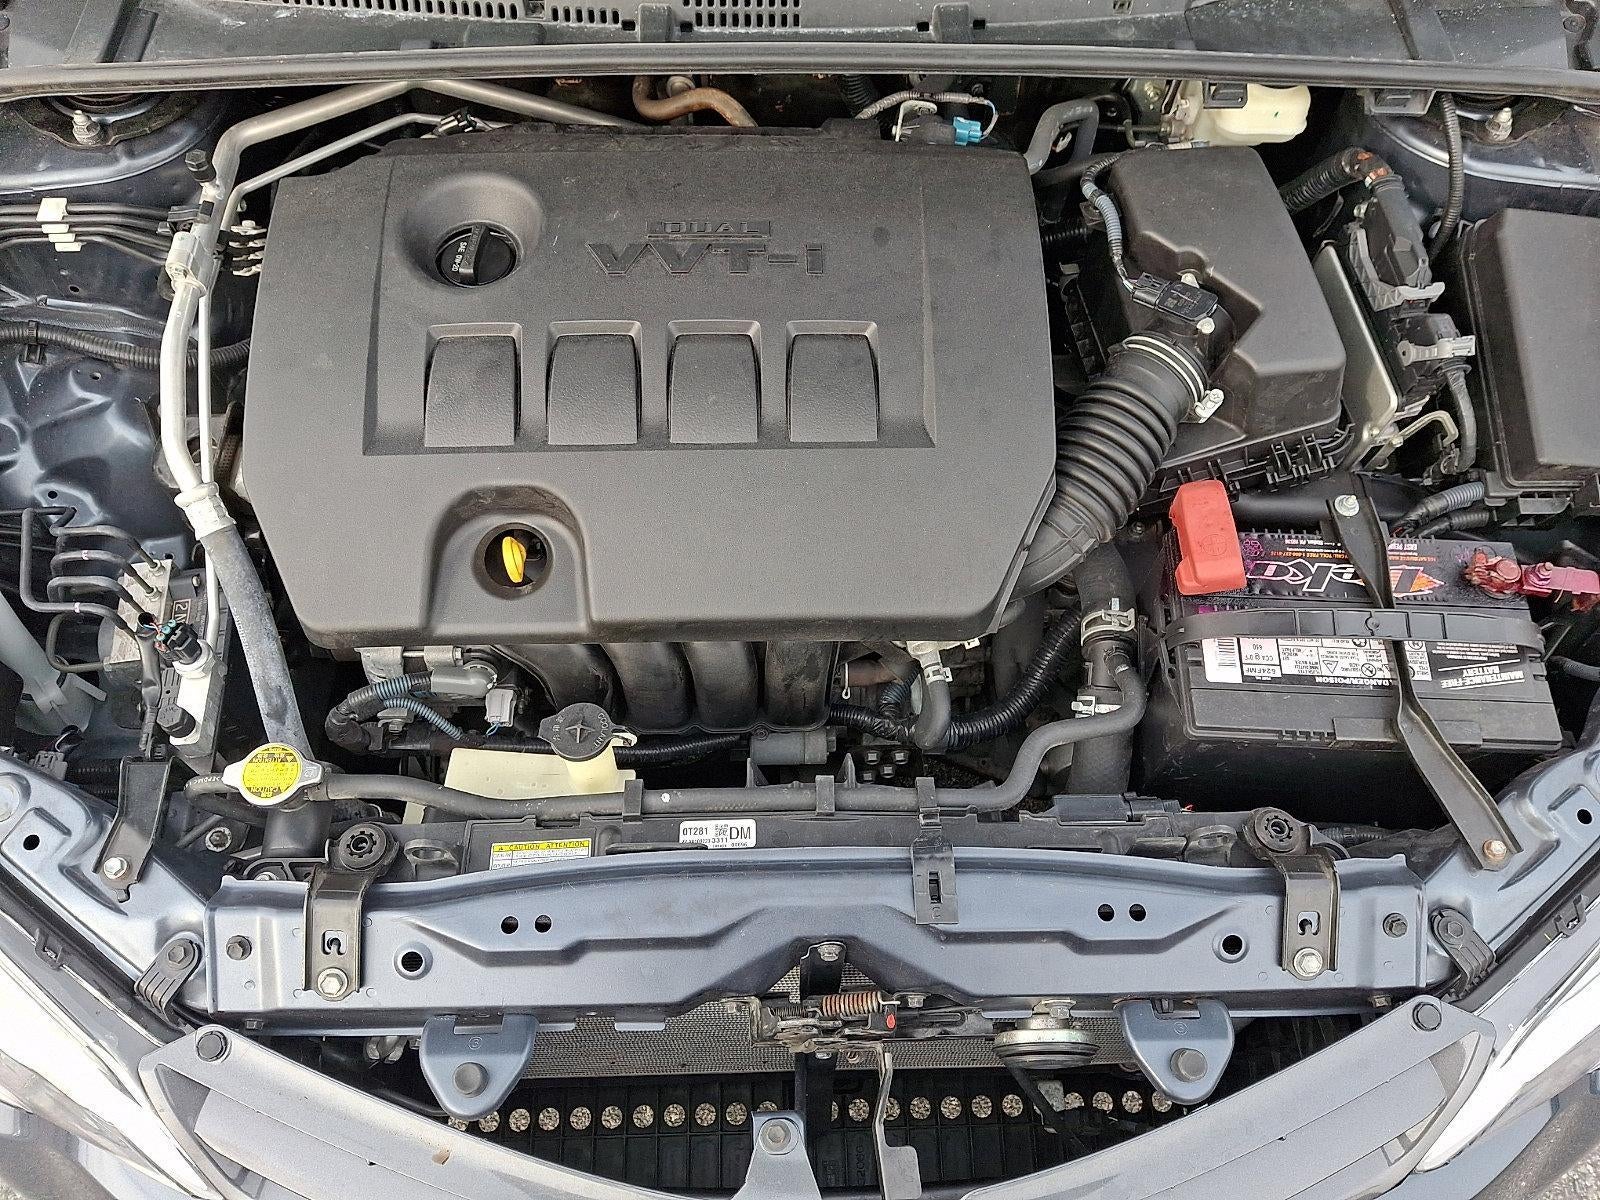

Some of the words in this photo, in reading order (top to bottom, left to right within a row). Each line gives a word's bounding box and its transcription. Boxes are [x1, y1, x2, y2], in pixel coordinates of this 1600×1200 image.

[662, 221, 759, 233] DUAL
[457, 241, 467, 253] SAE
[1462, 665, 1500, 678] BATTERY
[1315, 676, 1389, 687] DANGER/POISON
[1440, 670, 1524, 689] MAINTENANCE-FREE
[593, 712, 609, 748] COOLANT
[729, 826, 751, 840] DM
[546, 840, 585, 849] ATTENTION
